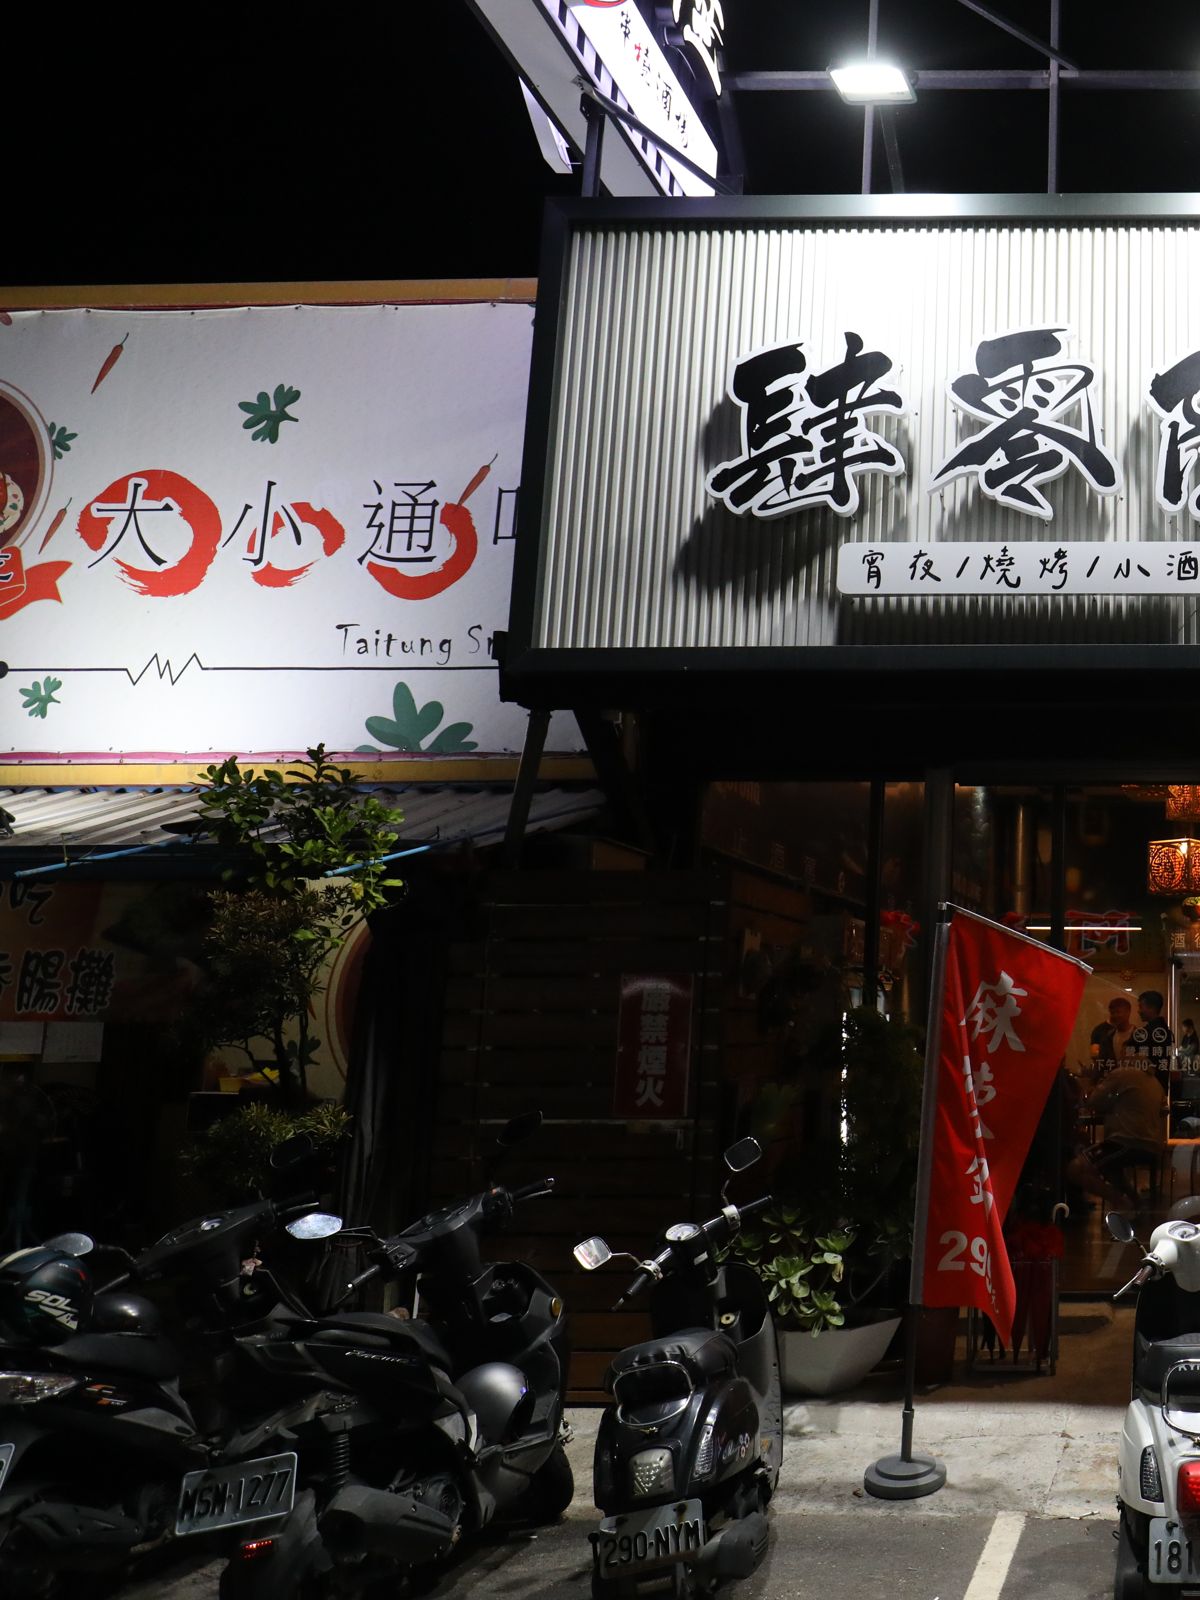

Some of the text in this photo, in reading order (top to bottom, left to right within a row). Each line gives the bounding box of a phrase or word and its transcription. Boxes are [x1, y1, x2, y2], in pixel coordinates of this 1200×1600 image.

[336, 623, 452, 665] Taitung
[24, 1289, 80, 1314] SOL
[604, 1519, 700, 1568] 290-NYM
